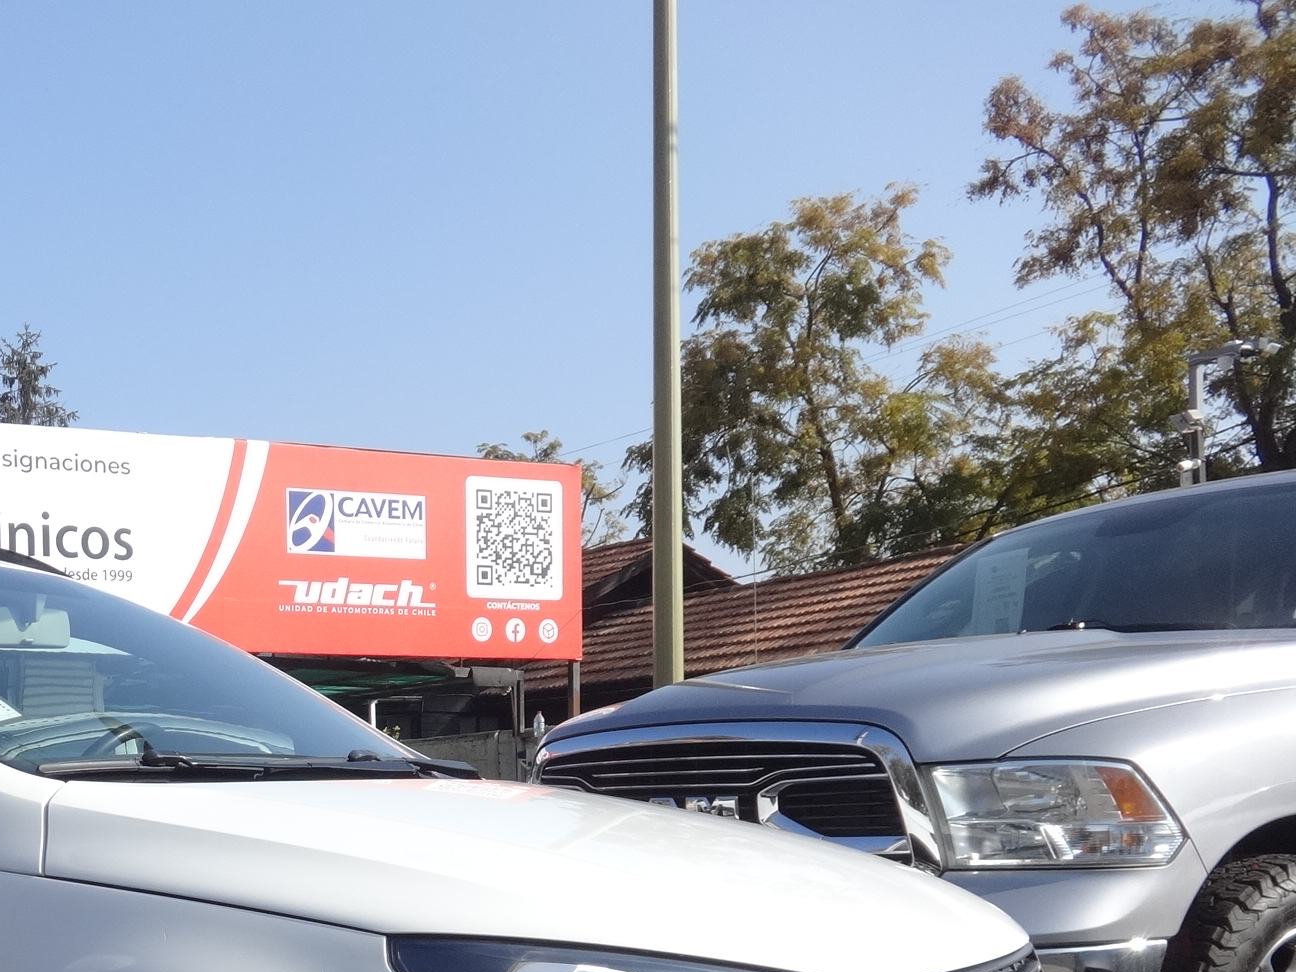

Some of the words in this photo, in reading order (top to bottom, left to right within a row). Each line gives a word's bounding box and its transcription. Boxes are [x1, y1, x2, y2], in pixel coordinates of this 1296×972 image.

[337, 496, 423, 520] CAVEM
[102, 569, 133, 582] 1999
[278, 576, 437, 608] udach
[278, 604, 313, 613] UNIDAD
[316, 605, 328, 613] DE
[331, 606, 395, 615] AUTOMOTORAS
[397, 608, 409, 616] DE
[411, 608, 436, 617] CHILE
[486, 601, 541, 611] CONTÁCTENOS
